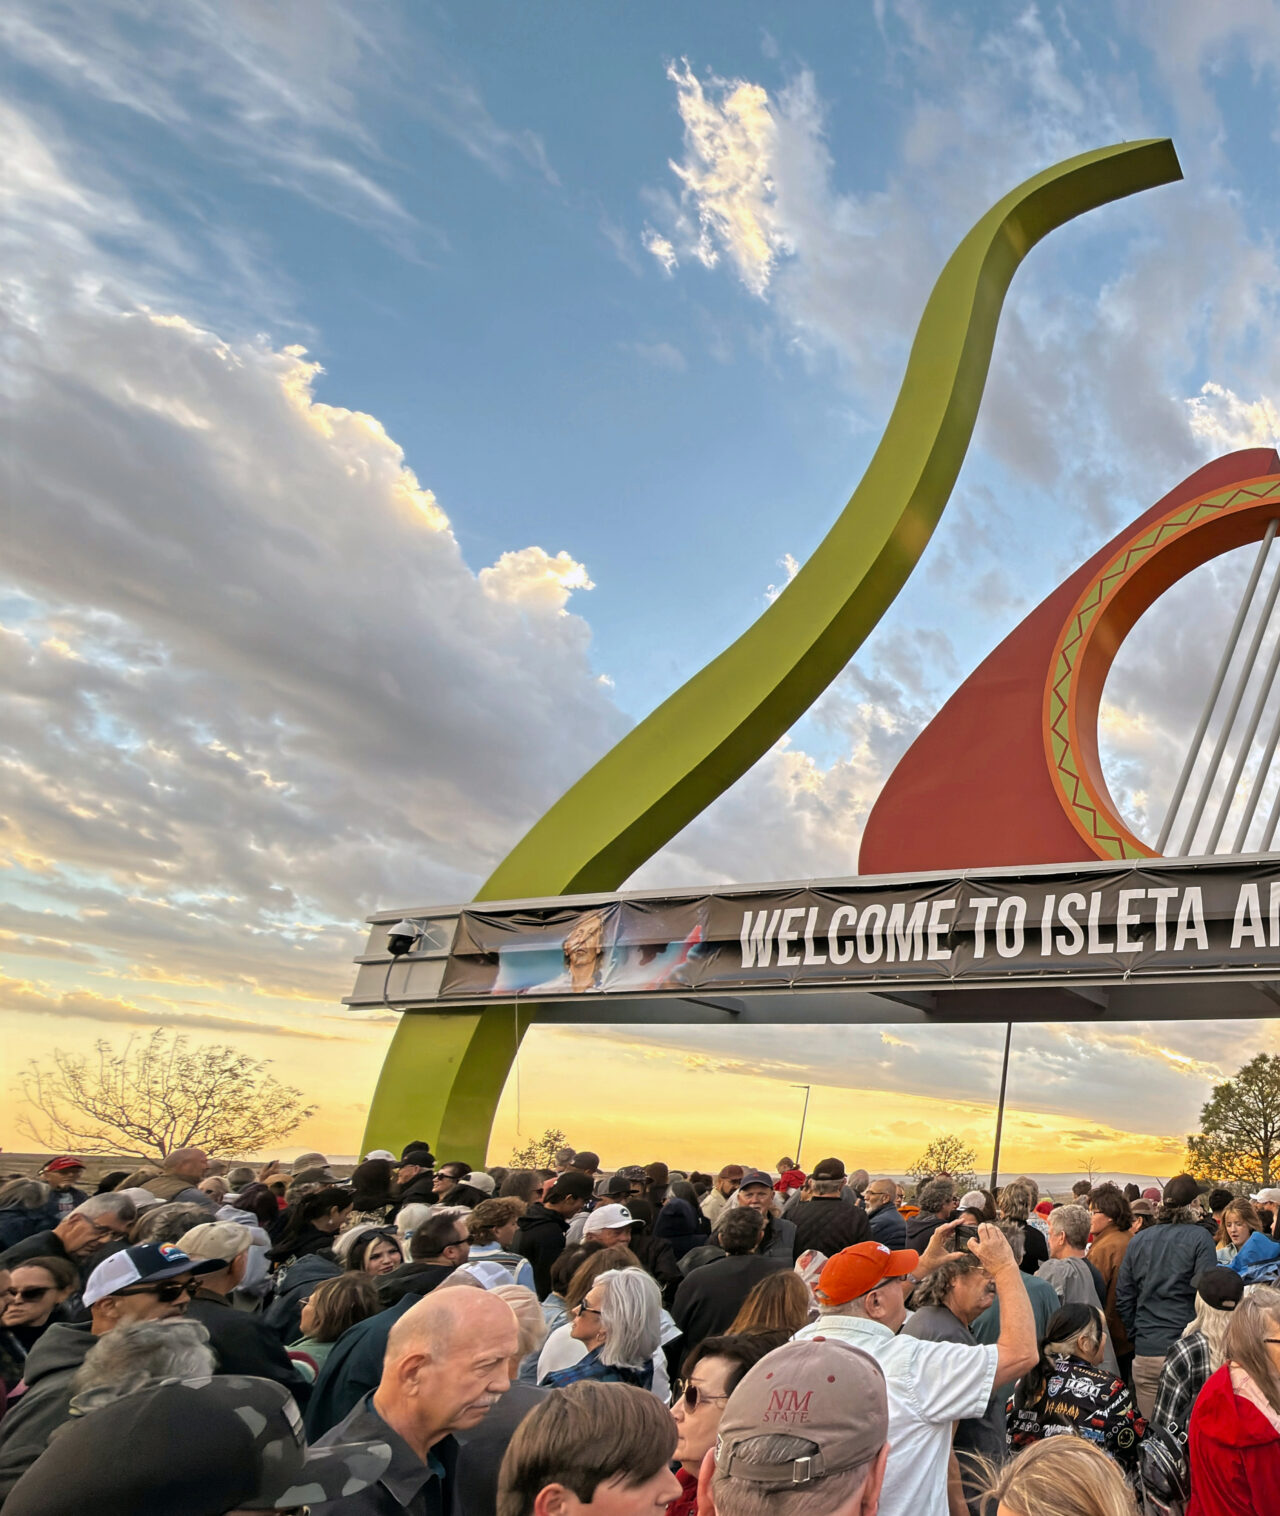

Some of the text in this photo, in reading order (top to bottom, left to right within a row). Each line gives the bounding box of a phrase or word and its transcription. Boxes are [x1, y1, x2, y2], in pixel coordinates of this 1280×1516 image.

[740, 898, 957, 968] WELCOME
[969, 895, 1028, 959] TO
[1041, 886, 1209, 956] ISLETA
[768, 1389, 815, 1411] NM
[762, 1411, 811, 1424] STATE
